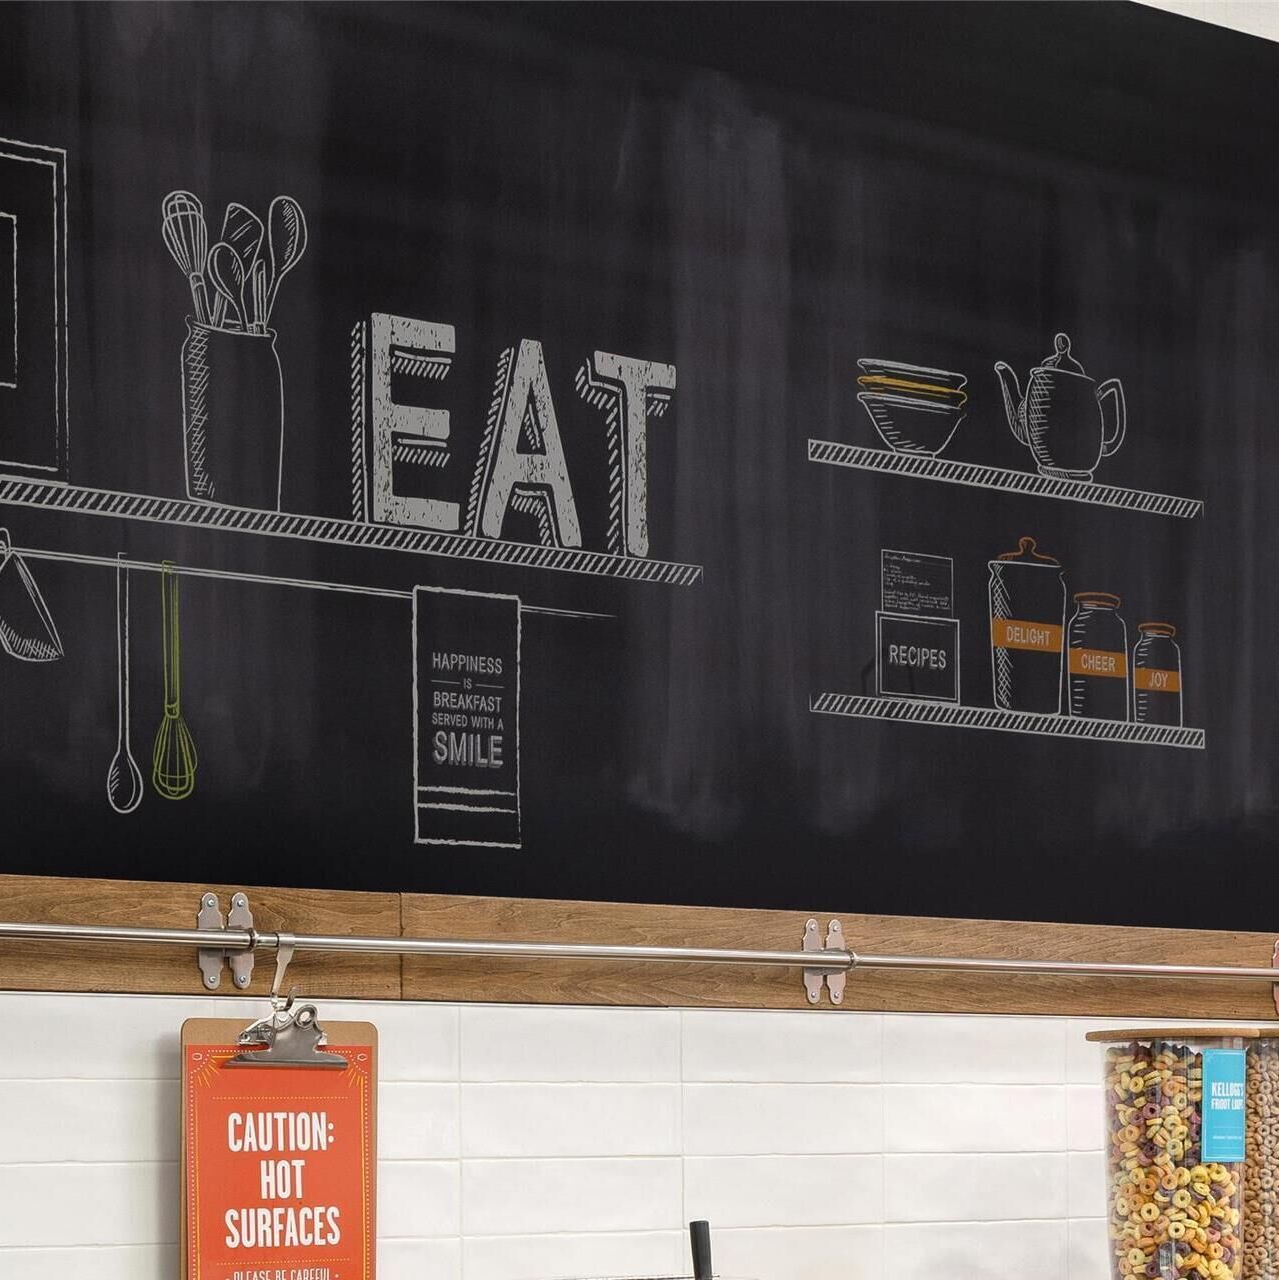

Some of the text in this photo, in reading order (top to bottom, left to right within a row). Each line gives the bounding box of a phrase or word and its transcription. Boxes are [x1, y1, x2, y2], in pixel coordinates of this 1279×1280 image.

[352, 311, 677, 558] EAT
[1006, 625, 1051, 647] DELIGHT
[432, 651, 503, 675] HAPPINESS
[888, 644, 947, 670] RECIPES
[1080, 653, 1116, 673] CHEER
[463, 677, 473, 690] IS
[1148, 671, 1169, 688] JOY
[433, 690, 503, 713] BREAKFAST
[431, 711, 505, 731] SERVED WITH A
[433, 730, 504, 768] SMILE
[227, 1111, 335, 1153] CAUTION:
[259, 1159, 306, 1200] HOT
[224, 1205, 341, 1249] SURFACES
